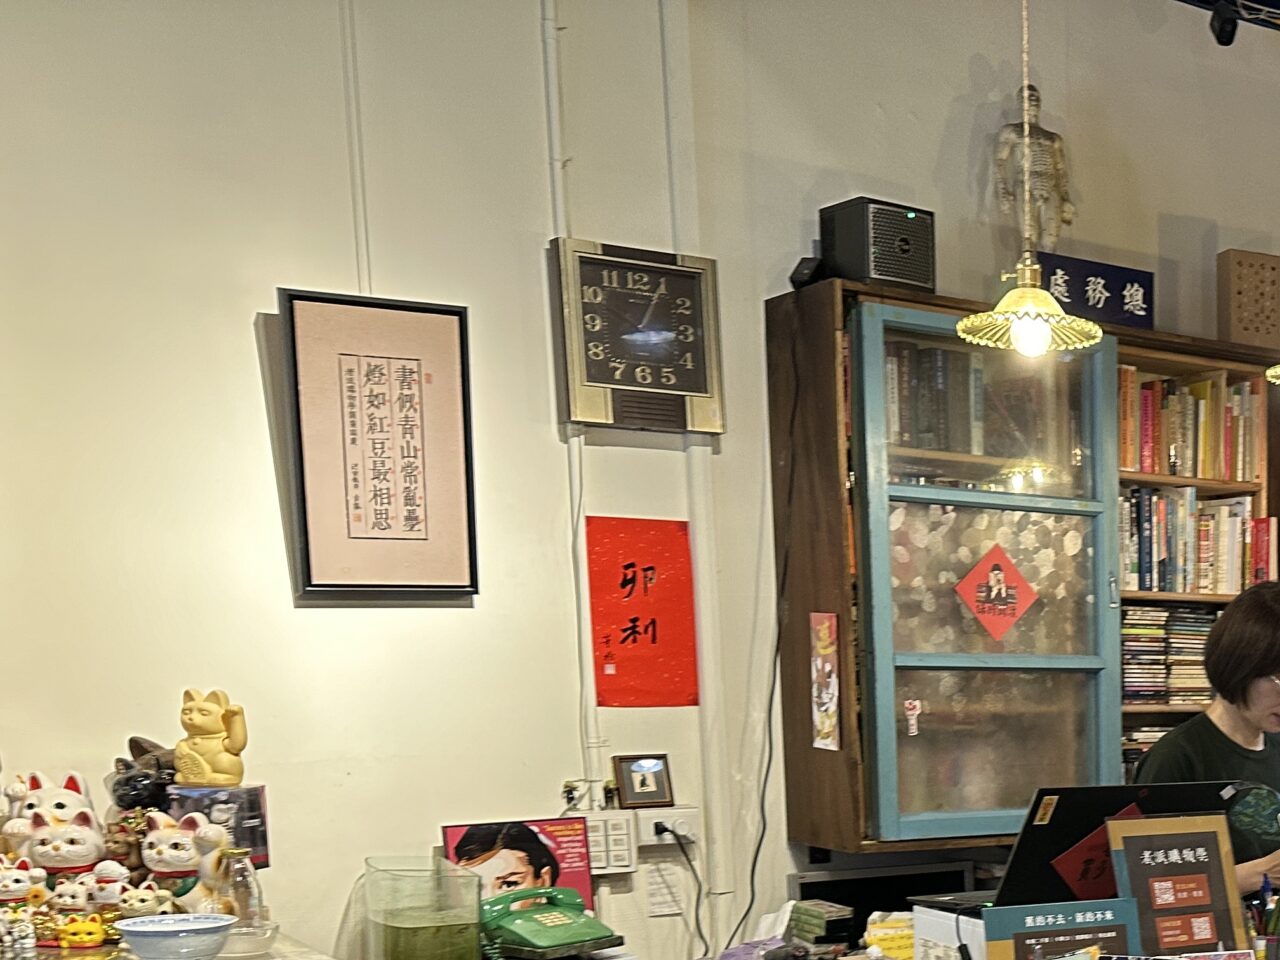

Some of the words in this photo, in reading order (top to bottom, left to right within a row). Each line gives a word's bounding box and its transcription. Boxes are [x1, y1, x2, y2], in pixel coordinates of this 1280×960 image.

[602, 270, 619, 288] 11
[626, 272, 650, 290] 12
[582, 286, 602, 304] 10
[677, 298, 692, 315] 2
[584, 314, 601, 332] 9
[678, 325, 694, 343] 3
[588, 342, 604, 360] 8
[680, 353, 695, 369] 4
[609, 363, 627, 380] 7
[635, 366, 652, 384] 6
[661, 368, 677, 385] 5
[363, 362, 392, 531] 燈如紅豆最相思
